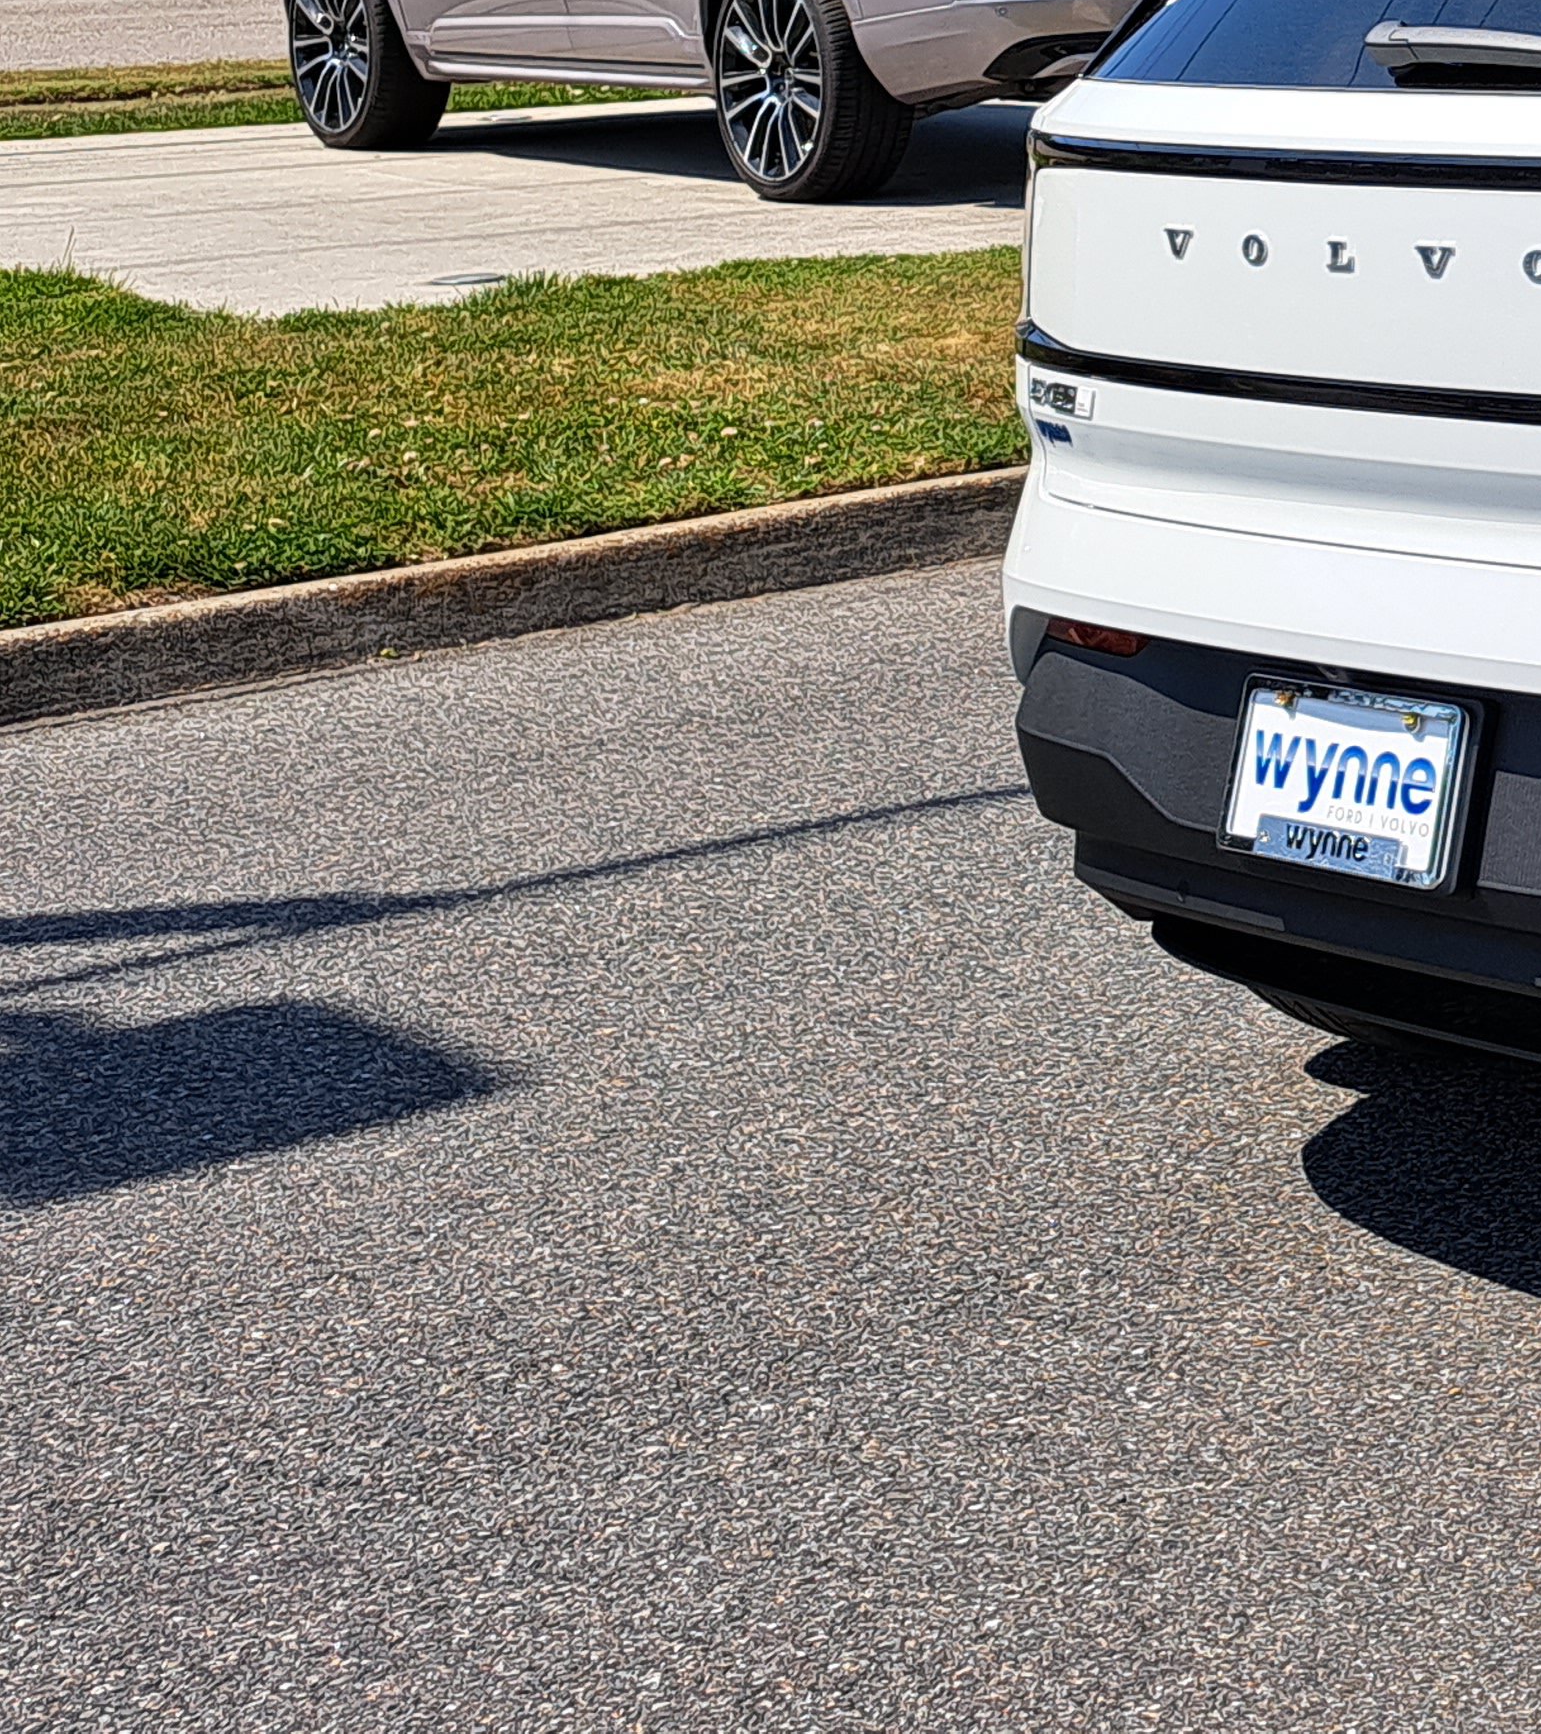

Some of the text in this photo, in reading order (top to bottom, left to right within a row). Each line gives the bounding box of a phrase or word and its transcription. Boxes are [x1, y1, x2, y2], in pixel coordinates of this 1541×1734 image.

[1255, 729, 1437, 815] wynne
[1326, 805, 1363, 824] FORD
[1380, 815, 1430, 838] VOLVO
[1286, 823, 1370, 862] wynne
